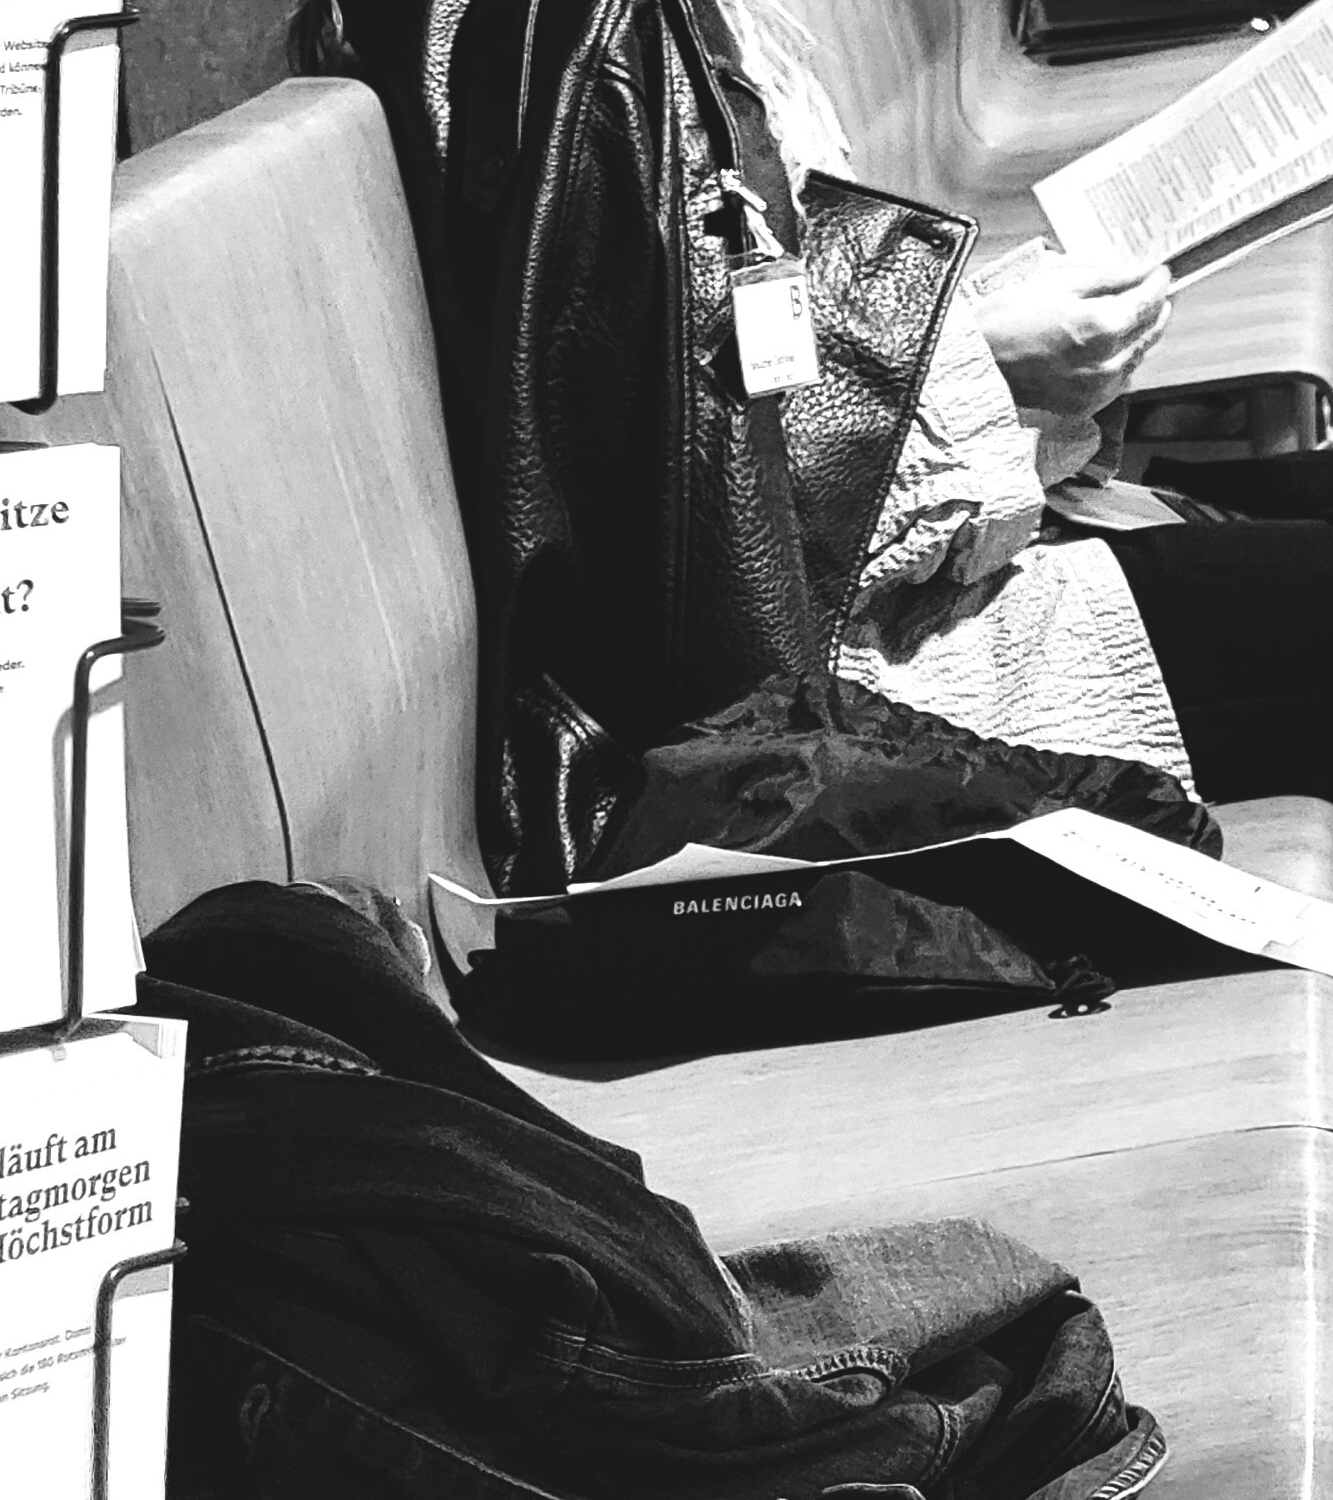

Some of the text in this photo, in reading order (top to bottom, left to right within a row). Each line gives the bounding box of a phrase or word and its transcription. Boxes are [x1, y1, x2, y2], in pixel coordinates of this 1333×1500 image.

[0, 498, 69, 531] itze
[673, 891, 802, 915] BALENCIAGA
[74, 1127, 117, 1159] am
[0, 1160, 151, 1223] tagmorgen
